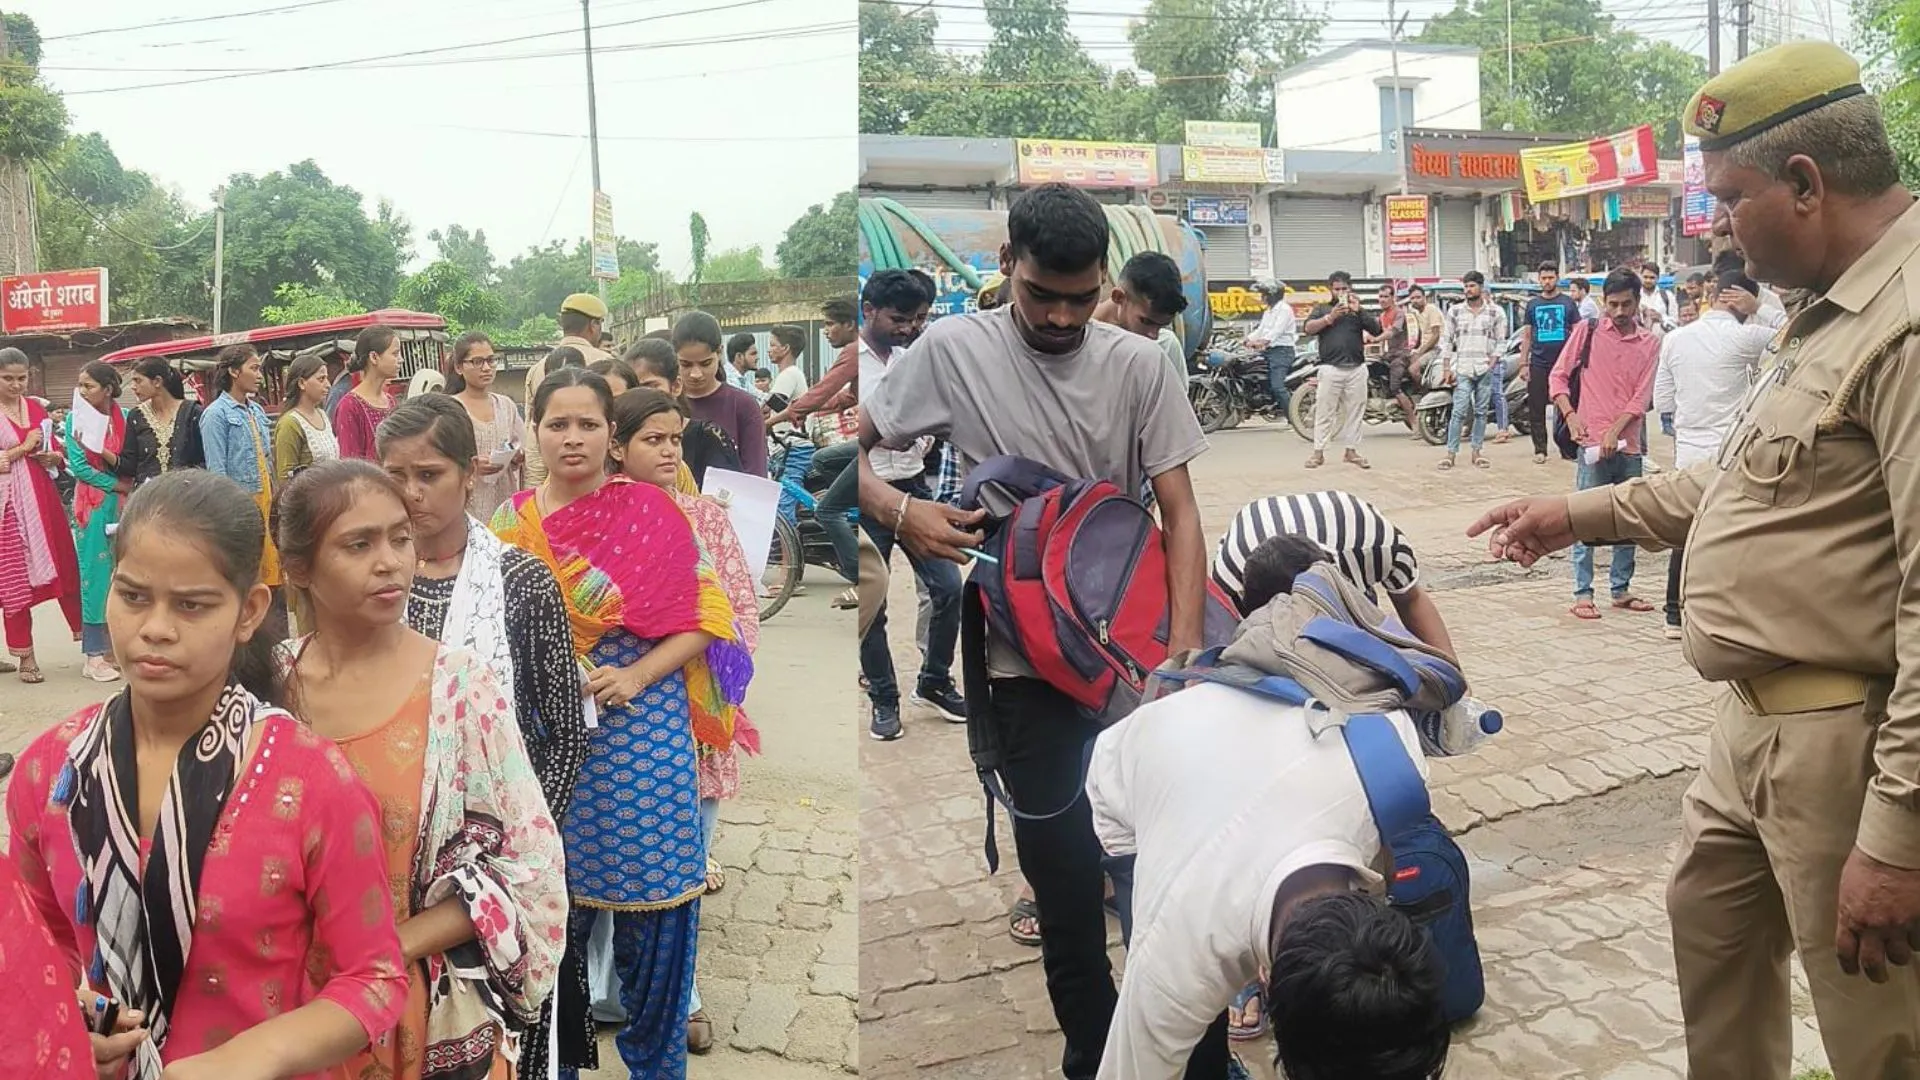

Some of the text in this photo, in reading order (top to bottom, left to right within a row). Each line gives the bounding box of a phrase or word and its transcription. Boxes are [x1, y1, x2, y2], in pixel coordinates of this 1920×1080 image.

[1059, 147, 1087, 158] राम
[1389, 200, 1425, 210] SUNRISE
[1389, 210, 1425, 219] CLASSES
[56, 283, 97, 306] शराब
